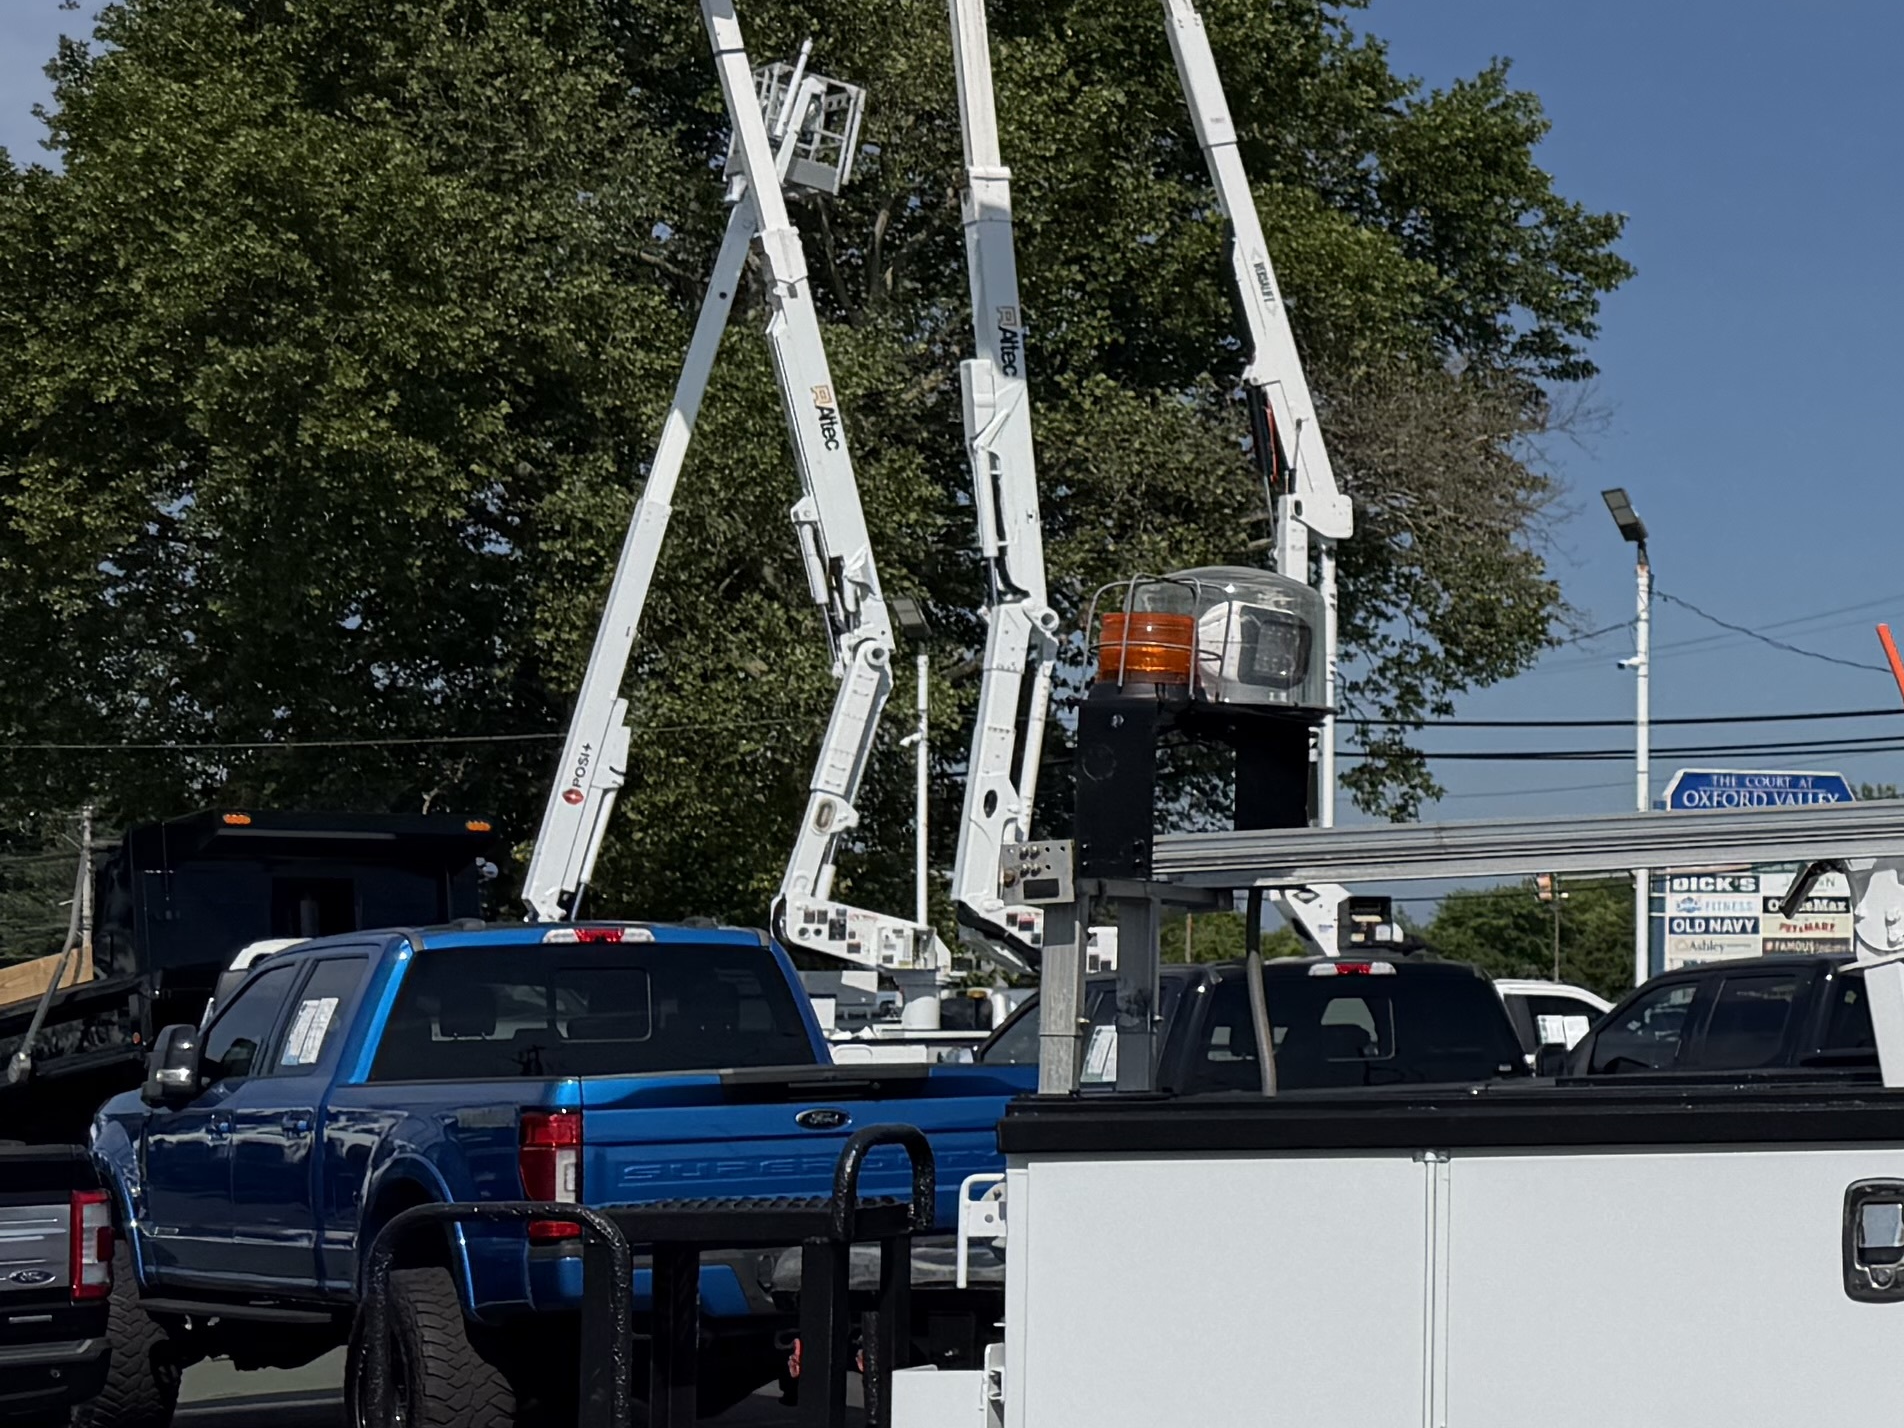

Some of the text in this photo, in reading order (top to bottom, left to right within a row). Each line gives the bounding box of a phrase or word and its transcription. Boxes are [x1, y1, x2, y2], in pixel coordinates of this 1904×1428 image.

[998, 325, 1019, 377] Altec
[815, 405, 840, 452] Altec
[1711, 775, 1814, 789] THE COURT AT
[1682, 789, 1840, 808] OXFORD VALLEY
[1672, 876, 1757, 892] DICK'S
[1704, 900, 1752, 913] FITNESS
[1671, 918, 1756, 934] OLD NAVY
[1689, 939, 1725, 954] Ashley
